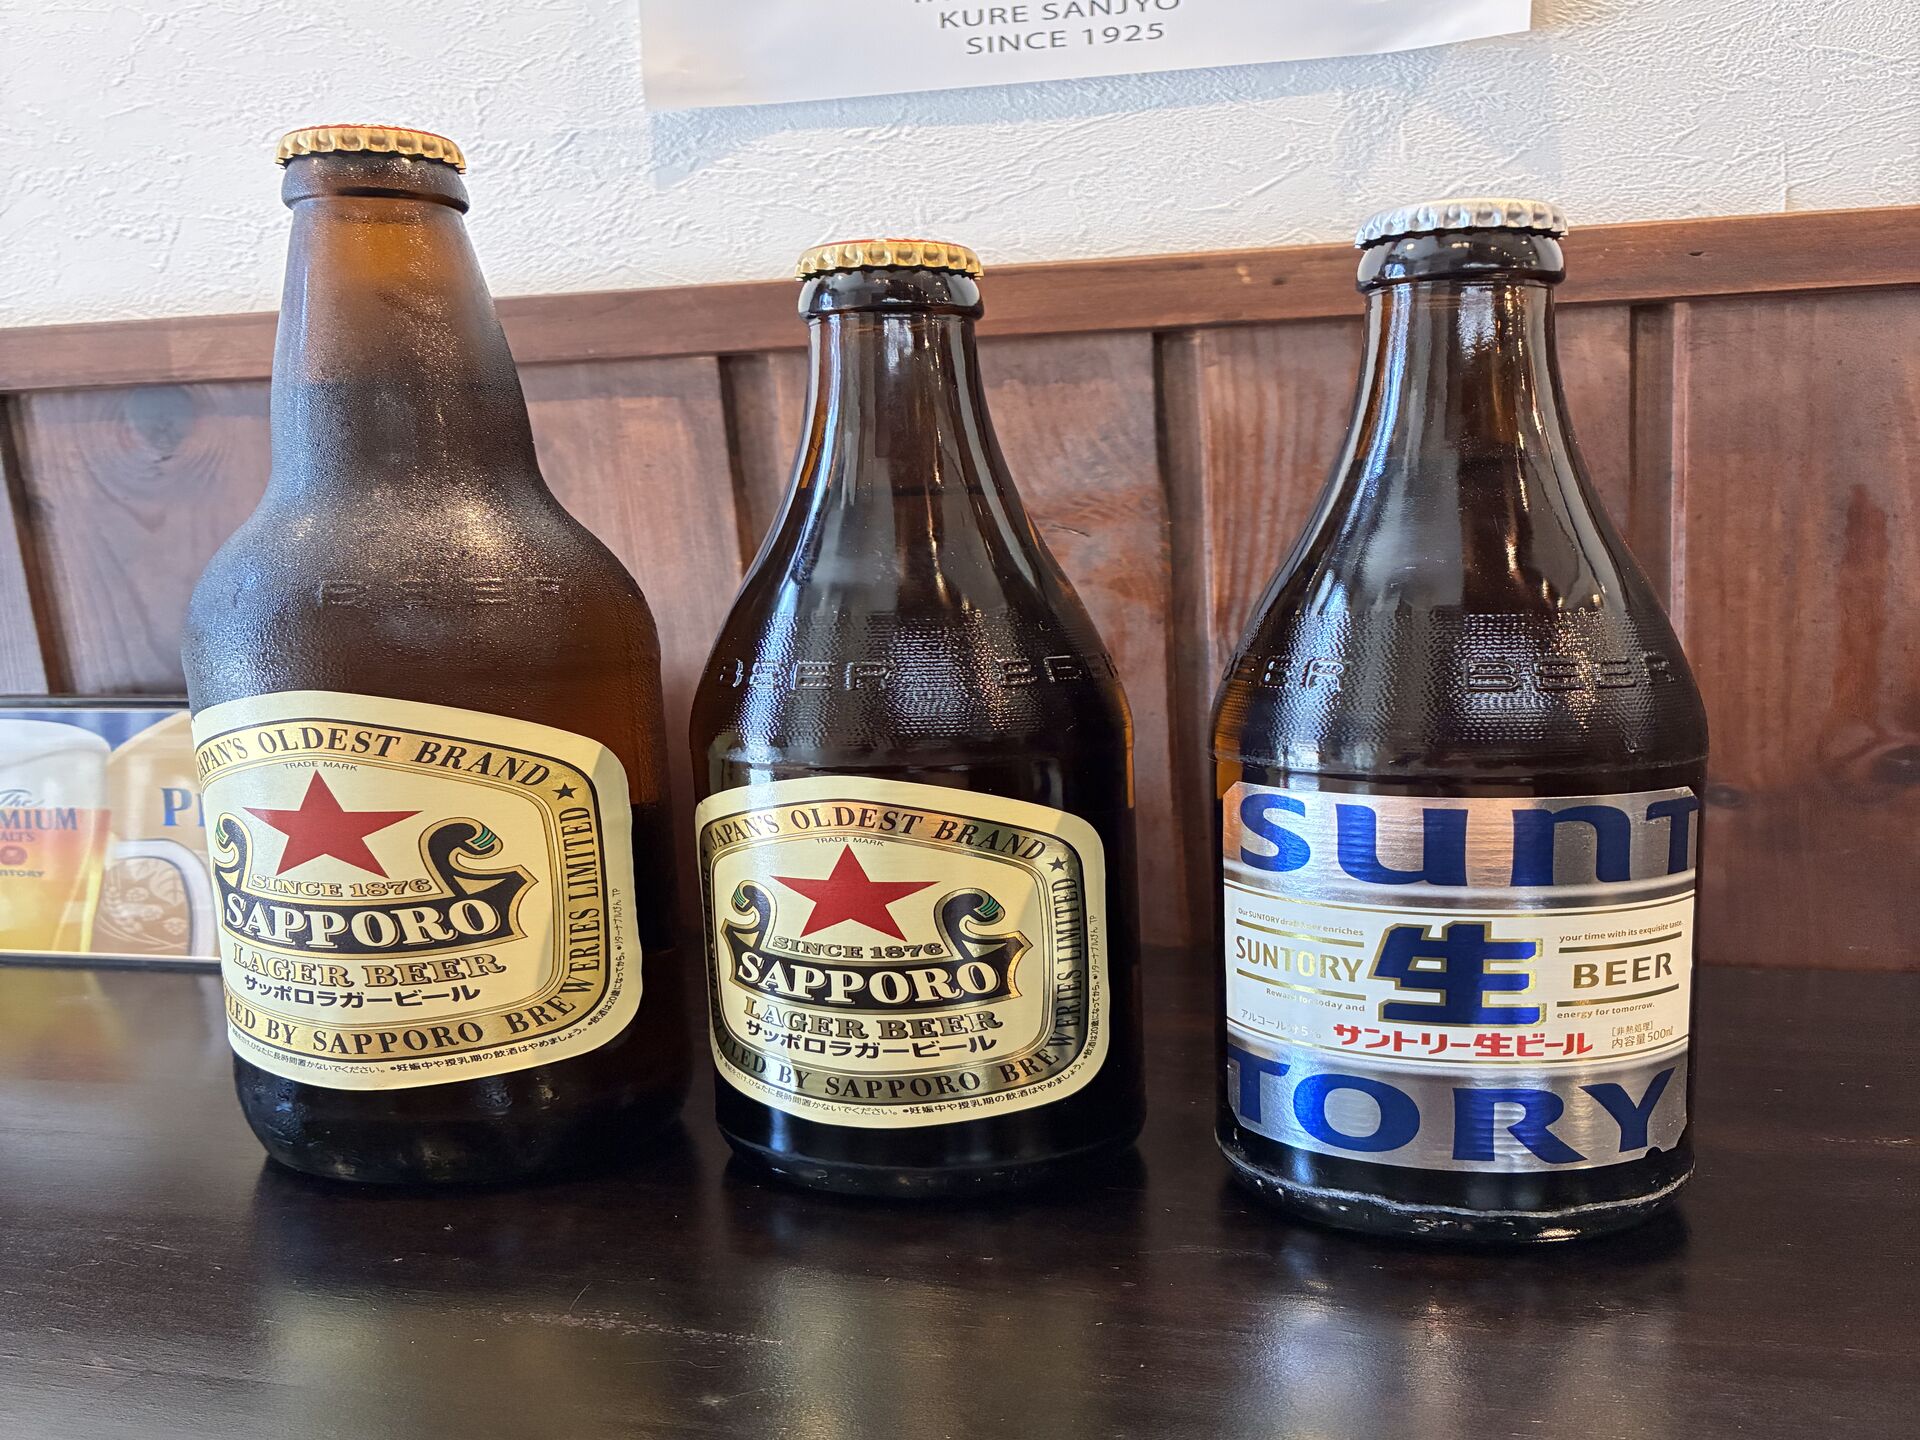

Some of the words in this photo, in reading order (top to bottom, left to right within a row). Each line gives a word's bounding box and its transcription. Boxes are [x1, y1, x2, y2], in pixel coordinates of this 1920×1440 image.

[940, 6, 1028, 28] KURE
[1041, 0, 1181, 20] SANJYO
[966, 30, 1067, 54] SINCE
[1083, 22, 1164, 45] 1925
[257, 727, 401, 758] OLDEST
[410, 740, 550, 786] BRAND
[283, 761, 319, 770] TRADE
[323, 761, 358, 771] MARK
[708, 813, 780, 850] JAPAN'S
[790, 806, 924, 835] OLDEST
[930, 819, 1047, 860] BRAND
[816, 837, 848, 845] TRADE
[853, 837, 884, 847] MARK
[558, 806, 599, 902] LIMITED
[251, 873, 342, 897] SINCE
[350, 878, 433, 898] 1876
[226, 892, 501, 949] SAPPORO
[1051, 878, 1082, 964] LIMITED
[1249, 910, 1281, 924] SUNTORY
[1322, 926, 1364, 937] enriches
[1559, 934, 1582, 944] your
[1584, 932, 1606, 940] time
[1607, 930, 1627, 938] with
[1628, 928, 1638, 936] its
[1639, 923, 1669, 935] exquisite
[233, 943, 355, 987] LAGER
[361, 953, 507, 988] BEER
[773, 935, 864, 959] SINCE
[870, 942, 944, 959] 1876
[1236, 935, 1363, 982] SUNTORY
[737, 951, 1000, 1005] SAPPORO
[1367, 920, 1546, 1028] 生
[1573, 952, 1673, 989] BEER
[244, 974, 481, 1008] サッポロラガービール
[1345, 1004, 1365, 1013] and
[744, 996, 869, 1039] LAGER
[876, 1010, 1004, 1039] BEER
[1556, 1010, 1593, 1019] energy
[1595, 1008, 1610, 1016] for
[1612, 1002, 1655, 1014] tomorrow.
[265, 1018, 298, 1045] BY
[313, 1021, 484, 1055] SAPPORO
[746, 1019, 998, 1059] サッポロラガービール
[1333, 1023, 1593, 1057] サントリー生ビール
[779, 1065, 812, 1088] BY
[824, 1071, 981, 1099] SAPPORO
[1228, 1043, 1676, 1164] TORY
